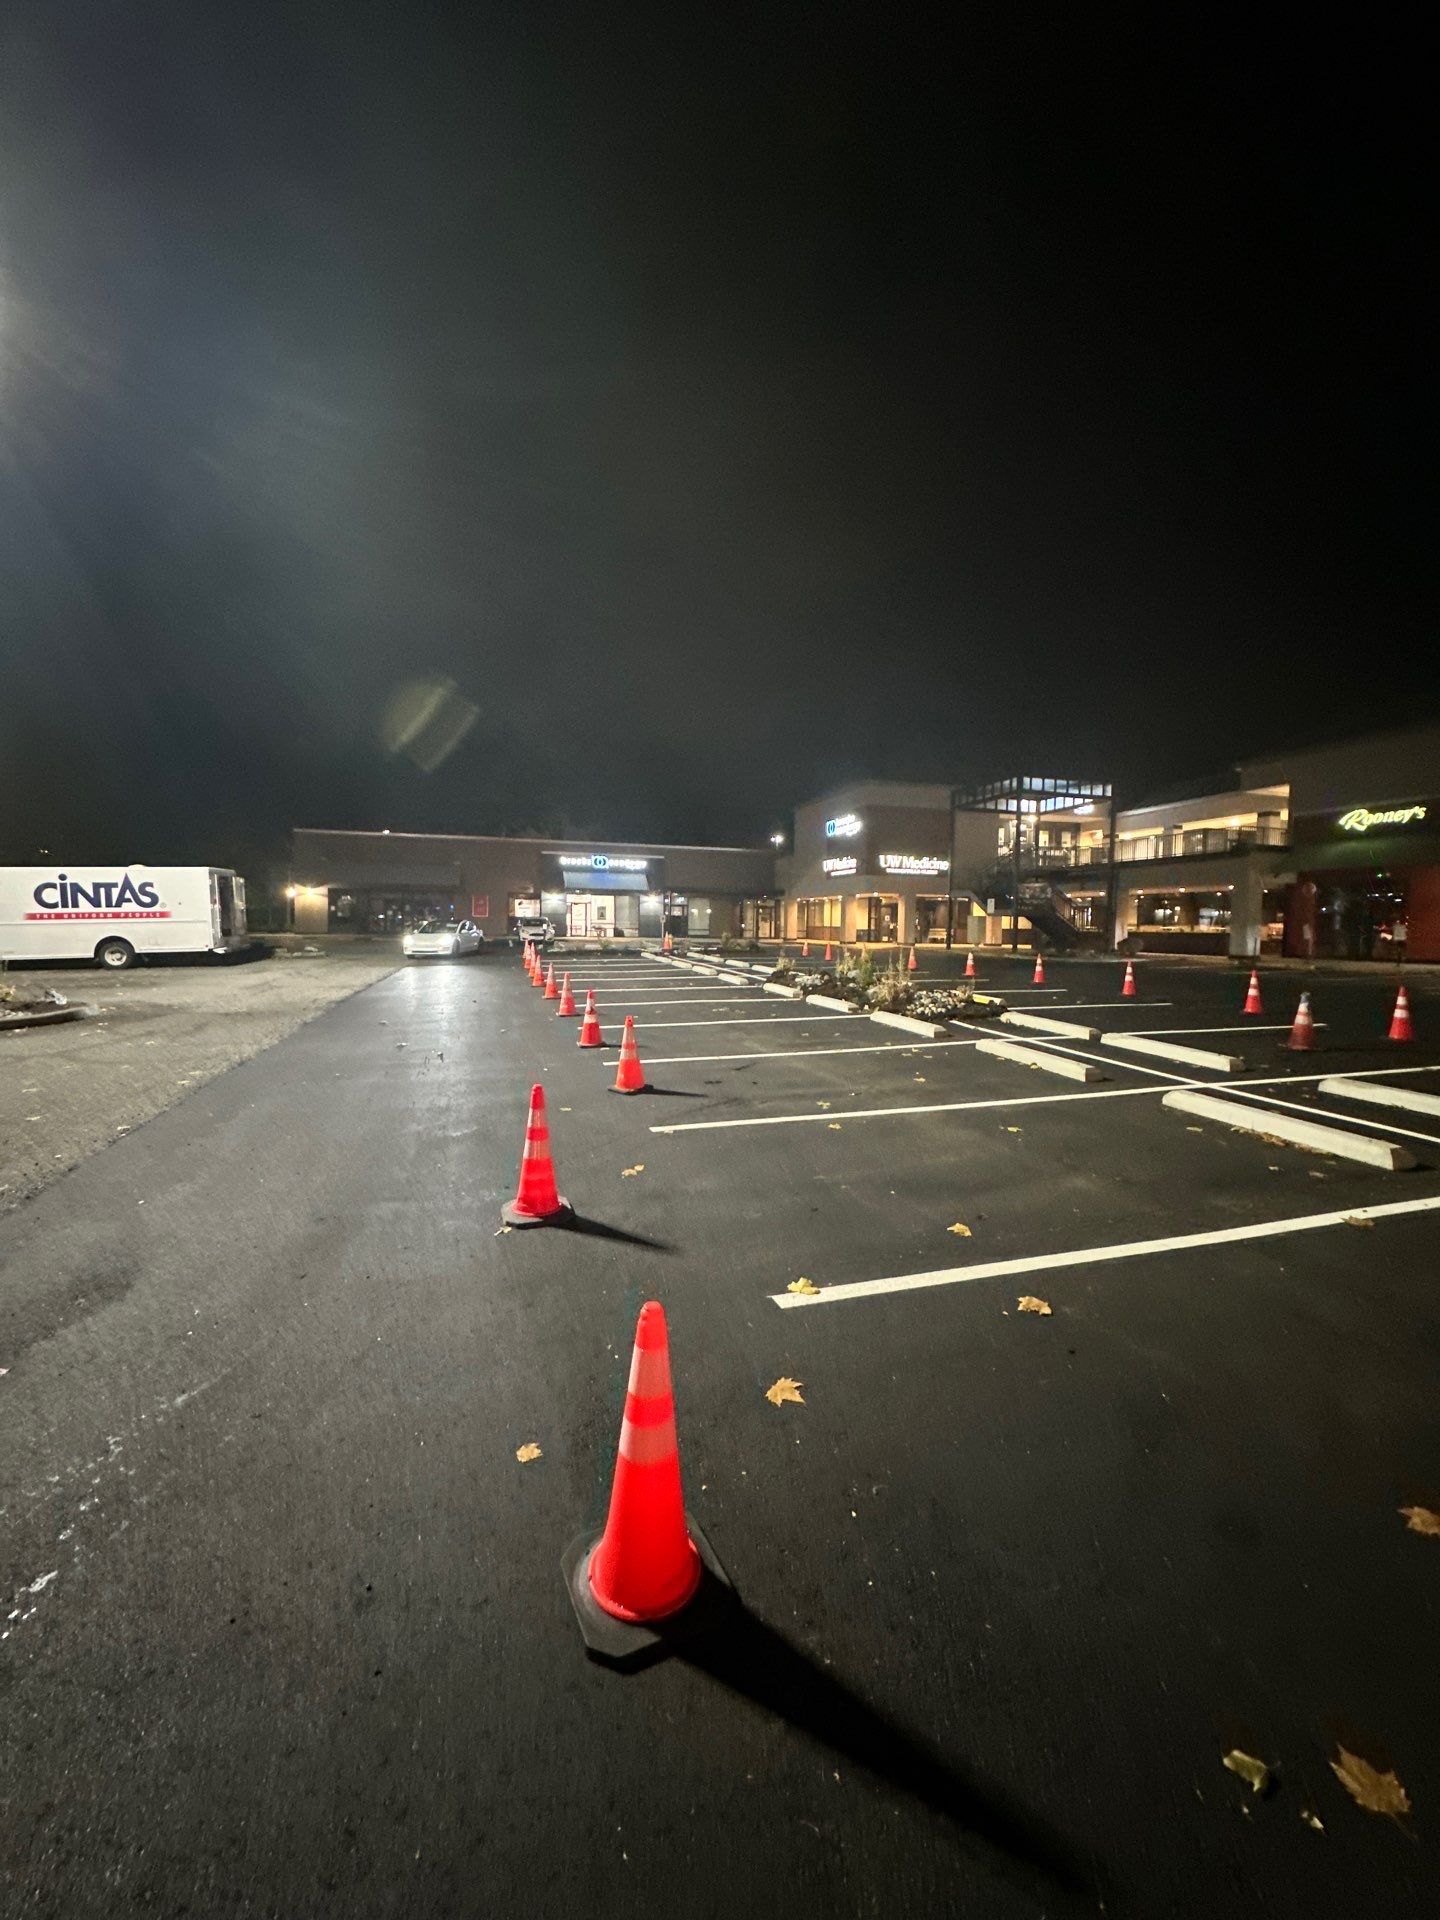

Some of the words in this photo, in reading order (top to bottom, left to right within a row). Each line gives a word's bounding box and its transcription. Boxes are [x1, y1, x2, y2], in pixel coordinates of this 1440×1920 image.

[1338, 805, 1427, 832] Rooney's
[879, 854, 902, 868] UW
[903, 856, 949, 870] Medicine
